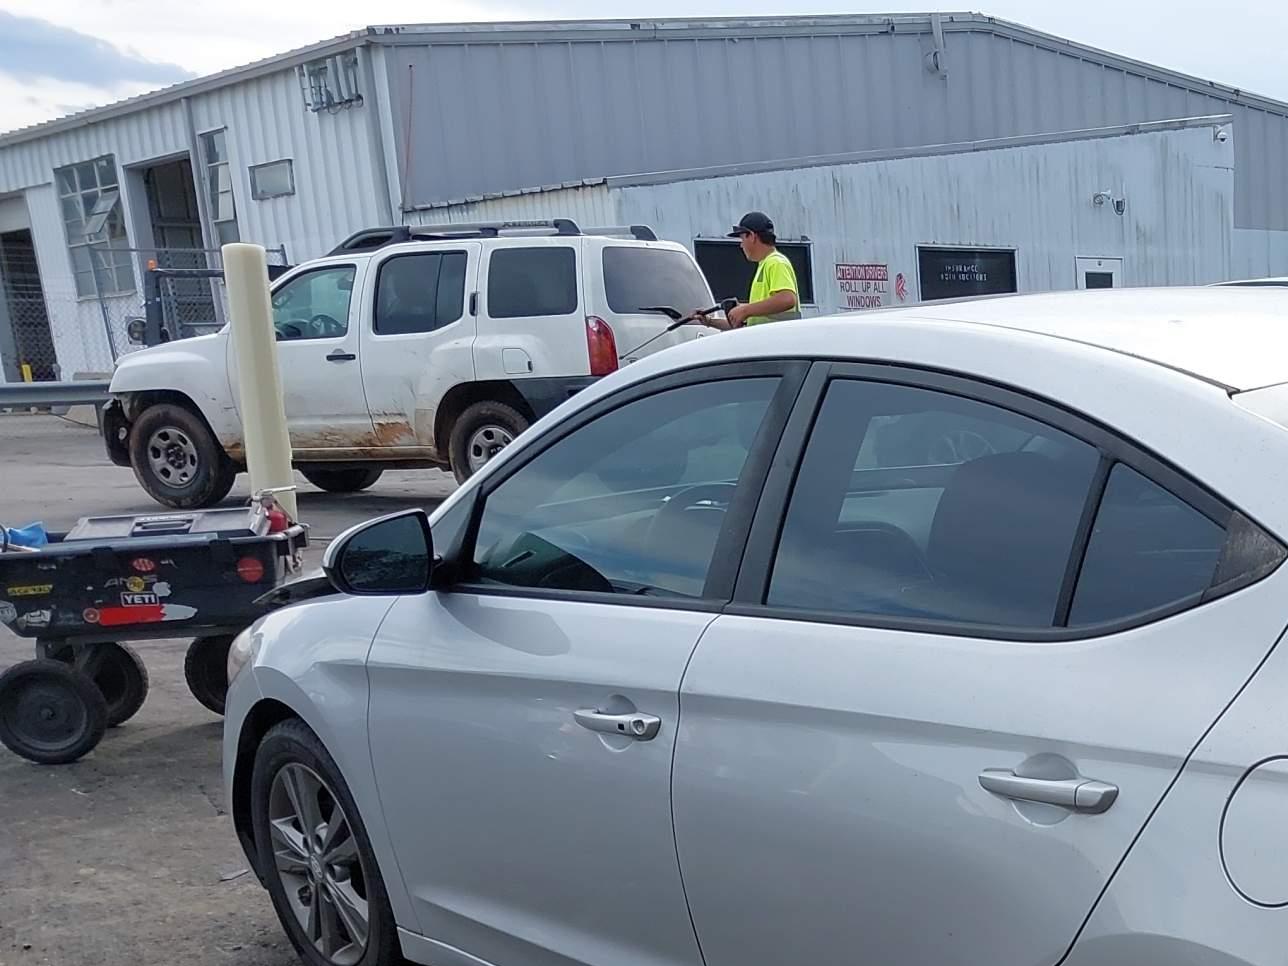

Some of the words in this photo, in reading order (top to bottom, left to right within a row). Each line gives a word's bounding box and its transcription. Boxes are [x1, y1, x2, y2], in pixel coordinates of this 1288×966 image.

[840, 281, 859, 292] ROLL
[861, 281, 871, 292] UP
[873, 282, 887, 293] ALL
[847, 295, 881, 308] WINDOWS
[124, 594, 155, 604] YETI
